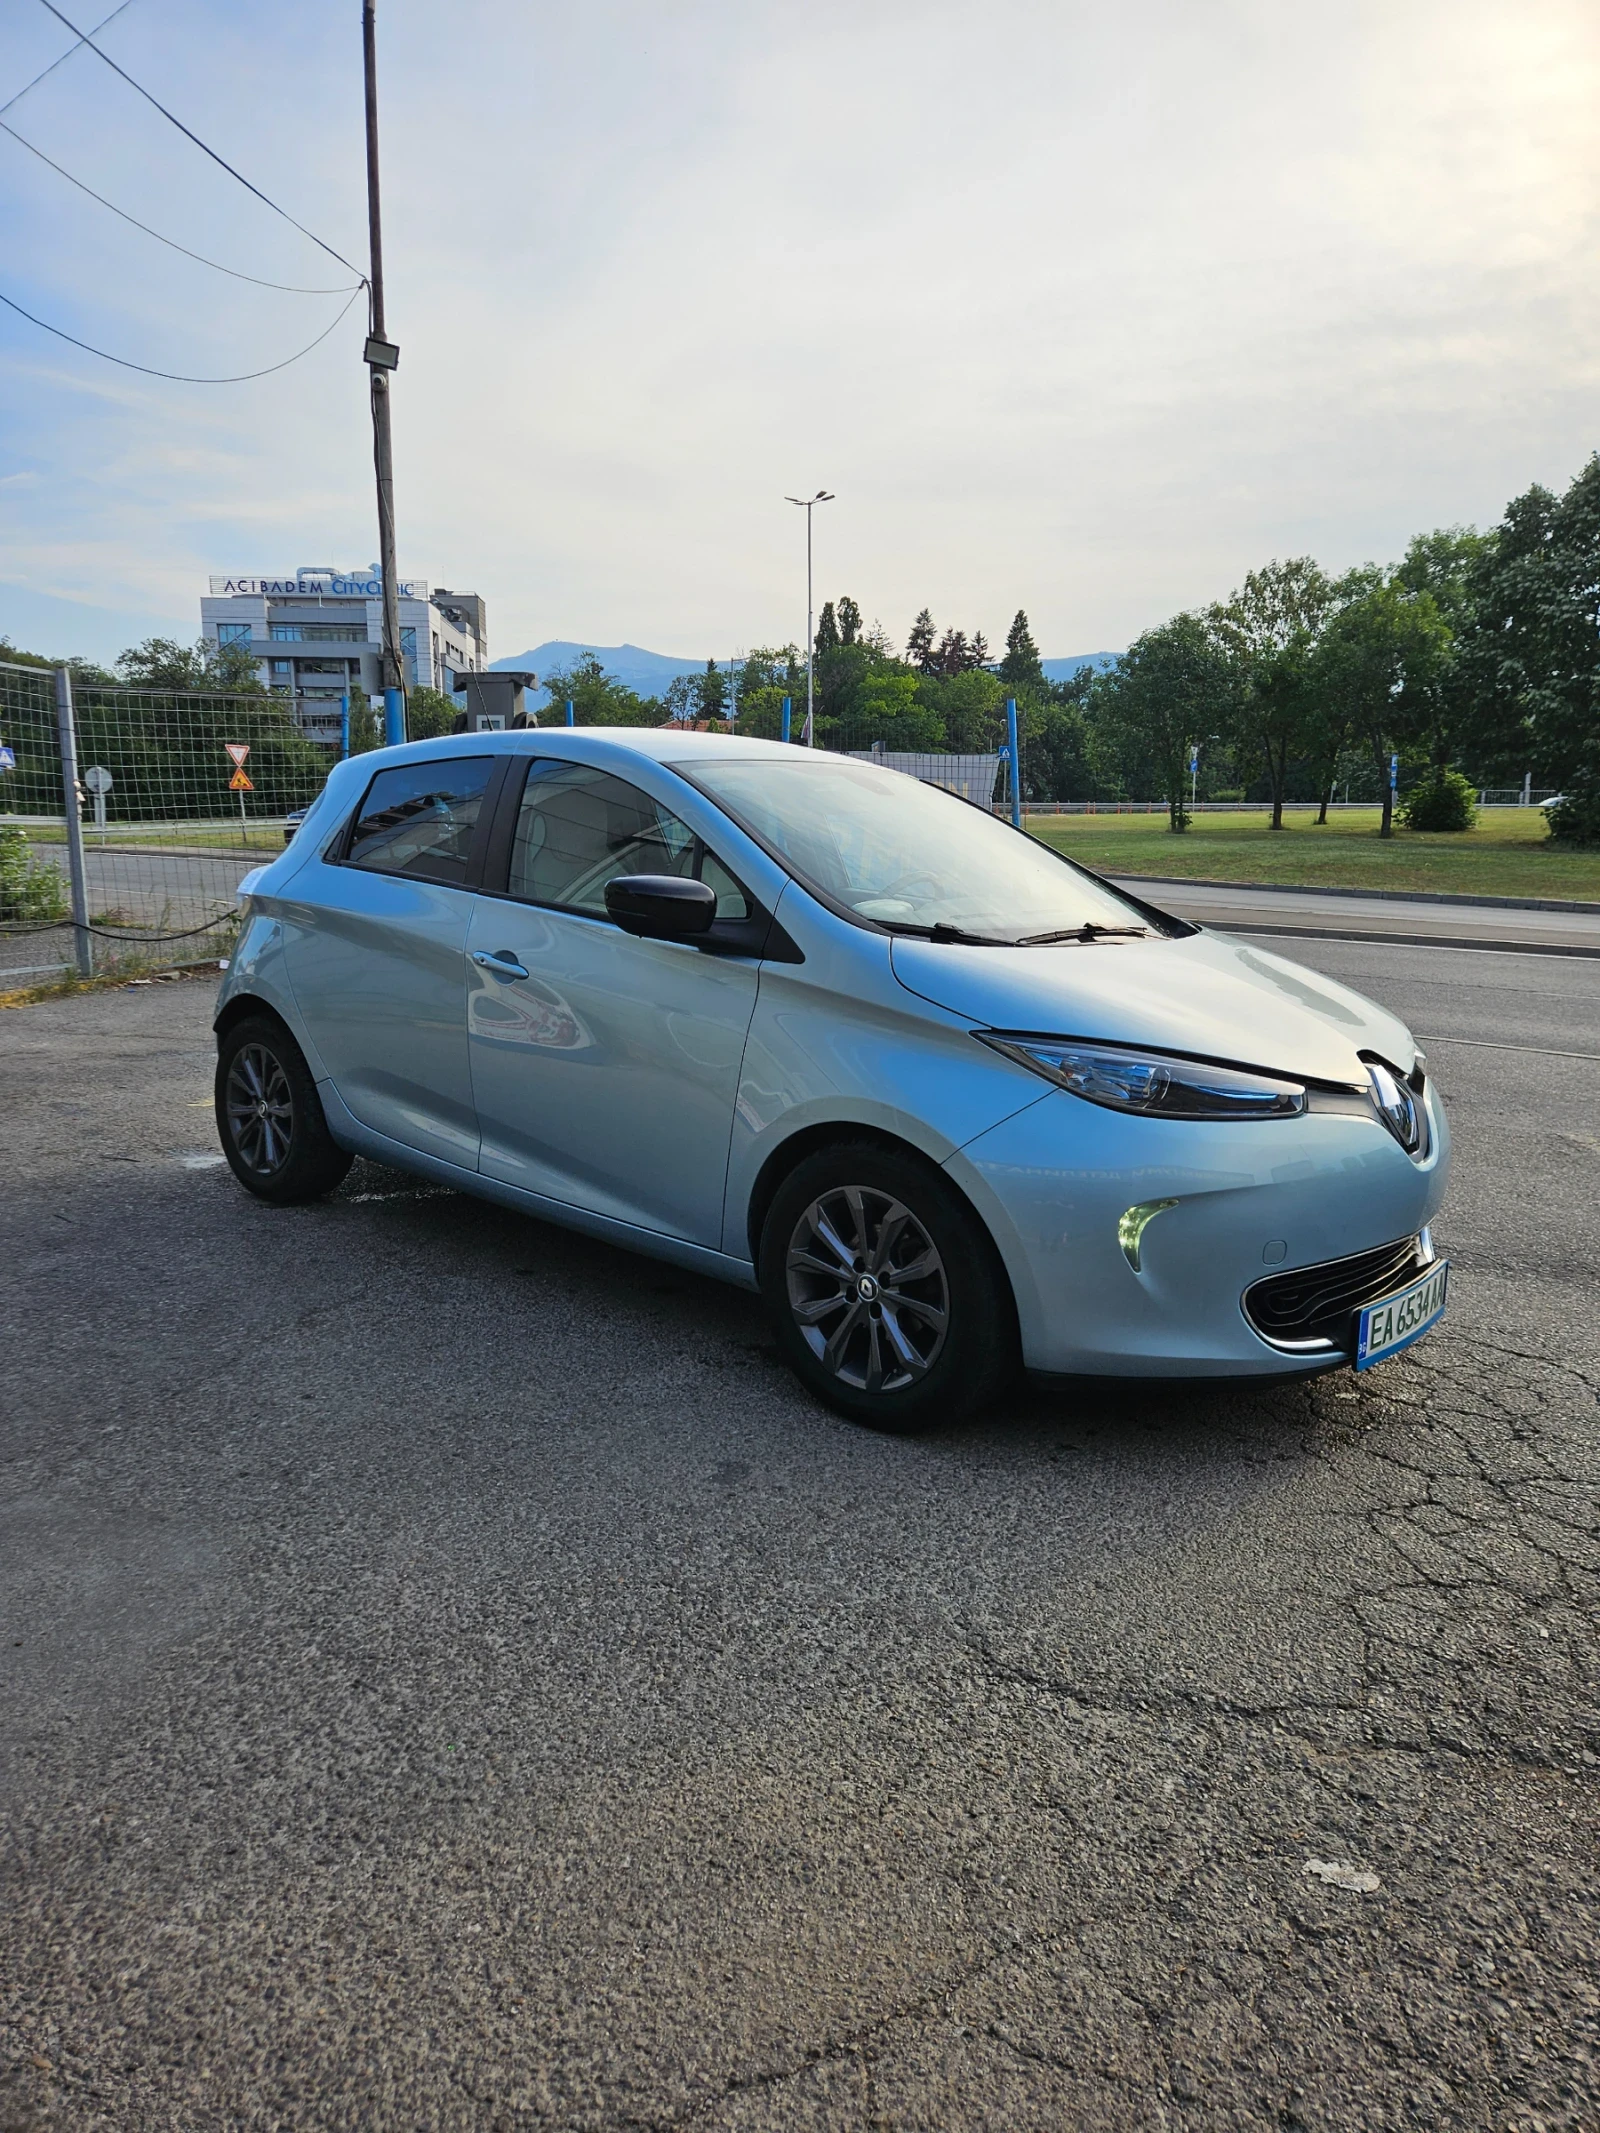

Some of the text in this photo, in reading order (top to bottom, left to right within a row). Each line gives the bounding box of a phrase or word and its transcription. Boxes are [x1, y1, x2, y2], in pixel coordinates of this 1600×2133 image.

[224, 579, 323, 594] ACIBADEM
[1370, 1305, 1392, 1350] EA
[1397, 1283, 1430, 1335] 6534
